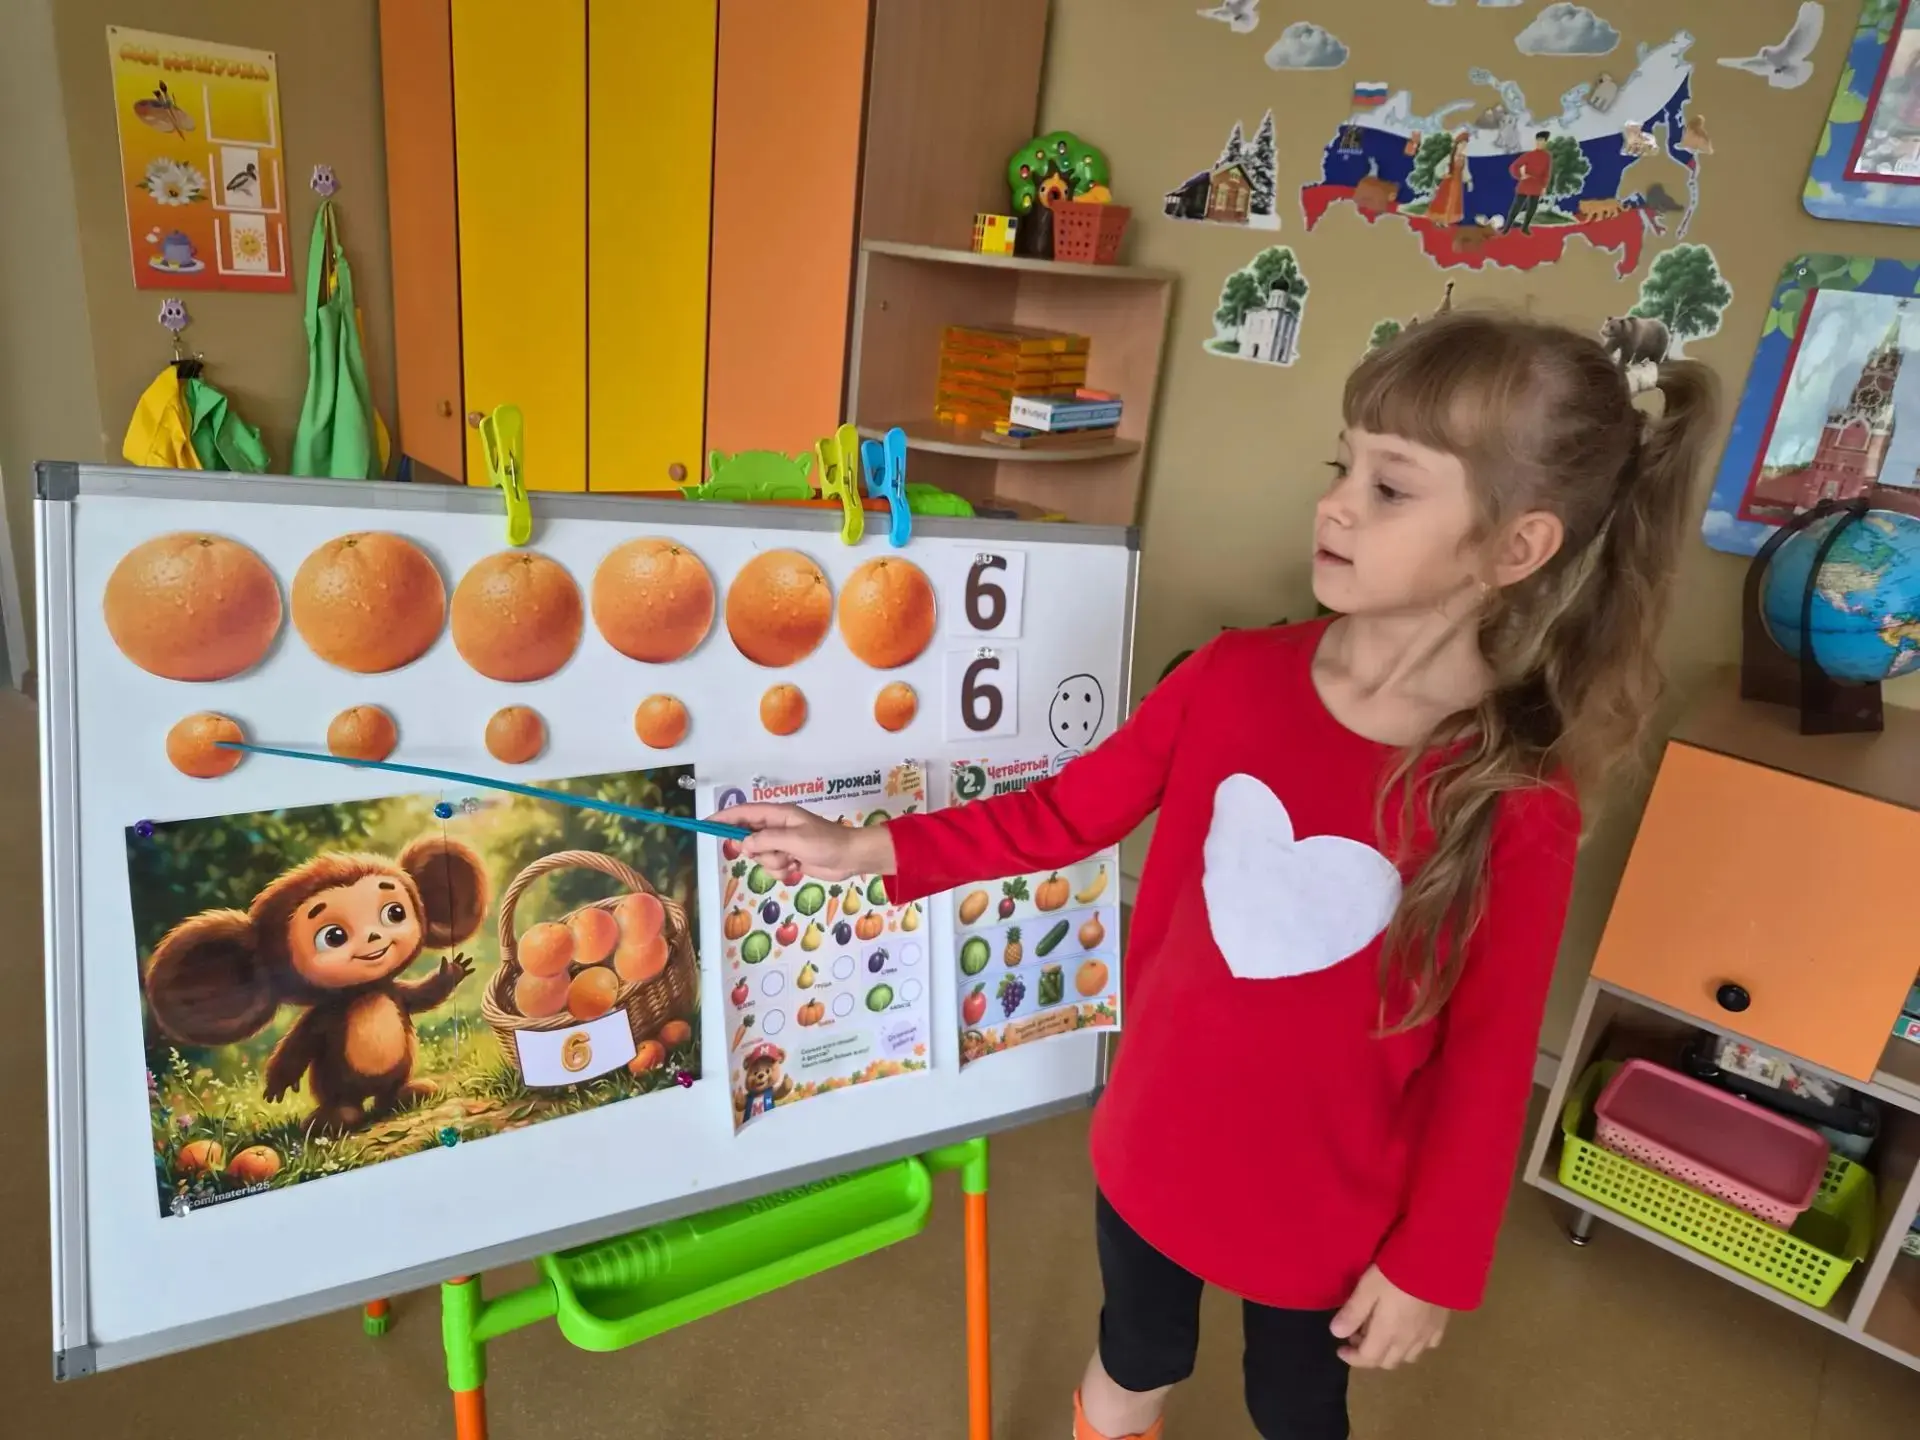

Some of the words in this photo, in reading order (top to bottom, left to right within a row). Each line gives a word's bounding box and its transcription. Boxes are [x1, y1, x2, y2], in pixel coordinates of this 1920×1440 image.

[964, 553, 1007, 631] 6
[961, 657, 1003, 732] 6
[963, 772, 981, 794] 2.
[987, 755, 1049, 779] Четвёртый
[752, 776, 824, 802] Посчитай
[827, 770, 881, 794] урожай
[993, 771, 1049, 796] лишн
[561, 1031, 593, 1073] 6
